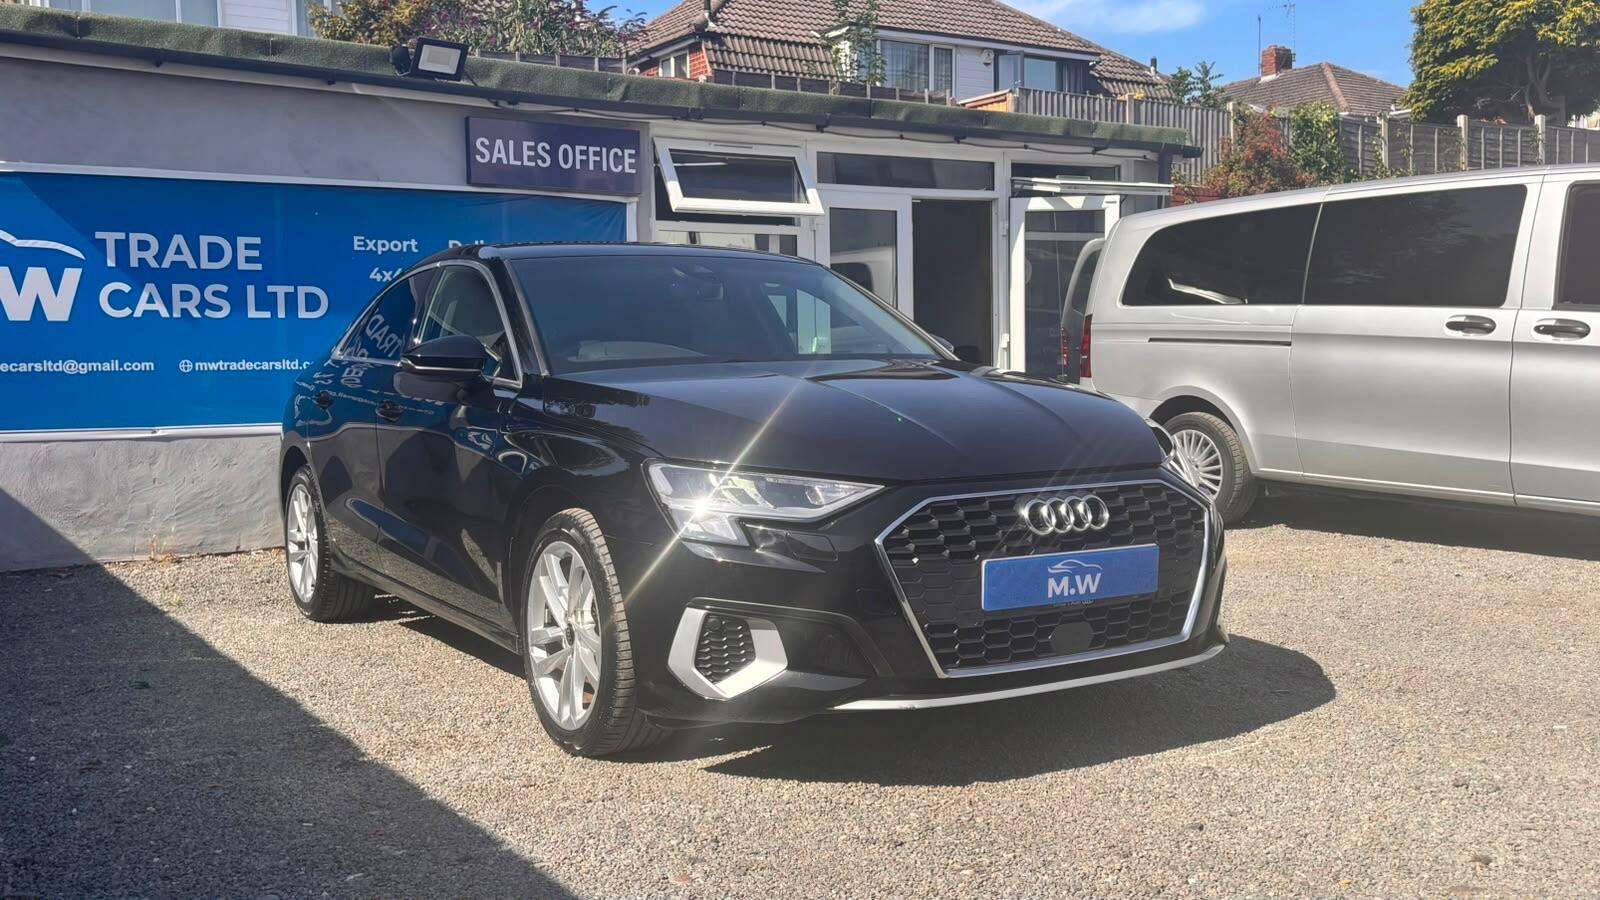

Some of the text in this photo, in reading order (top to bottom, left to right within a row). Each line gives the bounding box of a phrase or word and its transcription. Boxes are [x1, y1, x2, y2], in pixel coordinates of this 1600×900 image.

[475, 137, 637, 174] SALES OFFICE
[95, 231, 263, 271] TRADE
[353, 235, 419, 255] Export
[99, 282, 329, 319] CARS LTD
[195, 358, 314, 371] mwtradecarsltd.c
[1047, 572, 1102, 599] M.W
